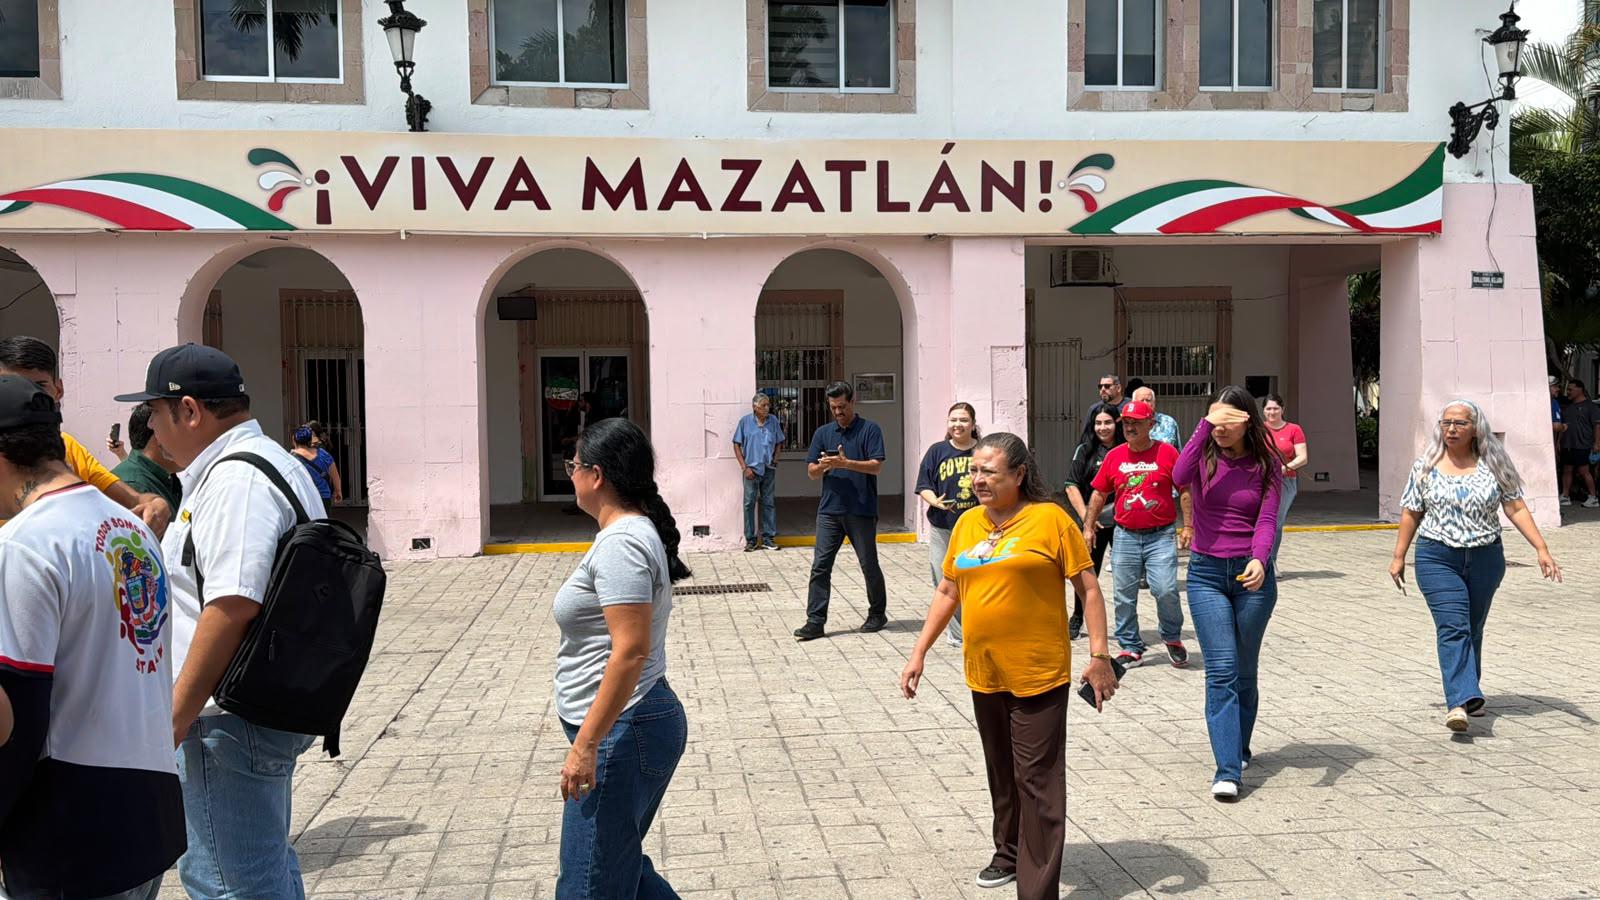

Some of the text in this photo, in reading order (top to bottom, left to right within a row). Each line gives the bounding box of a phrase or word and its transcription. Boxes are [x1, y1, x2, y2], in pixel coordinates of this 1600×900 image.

[315, 143, 1053, 224] ¡VIVA MAZATLÁN!
[1127, 402, 1135, 413] B
[95, 520, 112, 553] TODOS
